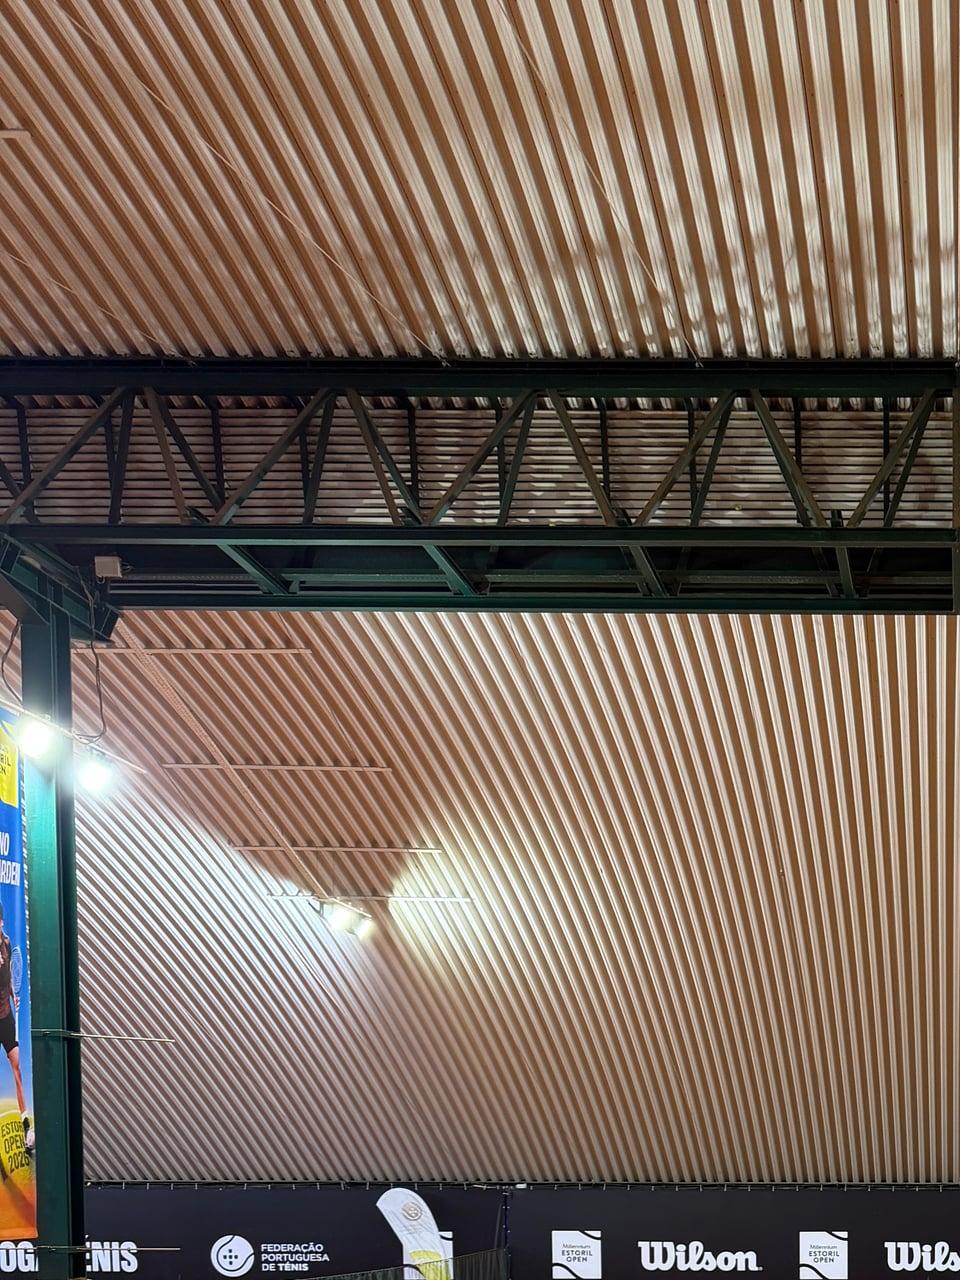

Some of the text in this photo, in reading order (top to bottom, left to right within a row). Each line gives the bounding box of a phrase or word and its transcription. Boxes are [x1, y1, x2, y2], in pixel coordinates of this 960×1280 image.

[261, 1242, 324, 1253] FEDERAÇÃO
[0, 1240, 39, 1273] OG
[261, 1253, 330, 1262] PORTUGUESA
[638, 1241, 760, 1272] Wilson
[261, 1262, 309, 1271] DE TÉNIS
